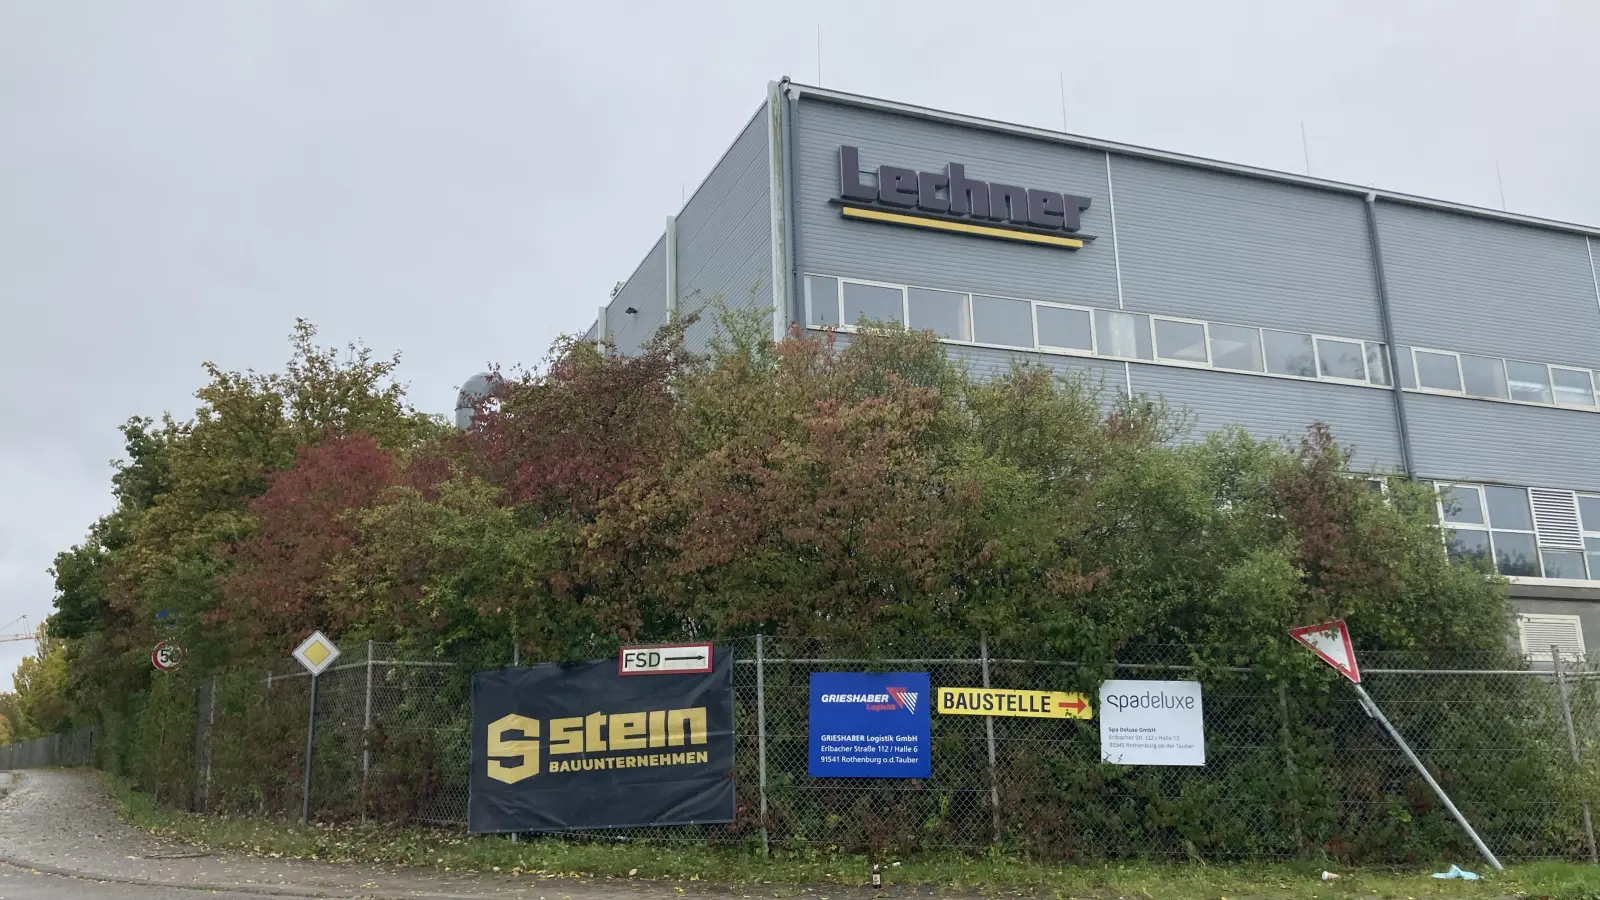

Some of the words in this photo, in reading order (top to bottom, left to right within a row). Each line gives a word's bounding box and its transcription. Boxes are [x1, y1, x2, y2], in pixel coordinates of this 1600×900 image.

[838, 145, 1092, 232] Lechner
[624, 652, 661, 668] FSD
[821, 694, 889, 703] GRIESHABER
[943, 692, 1051, 713] BAUSTELLE
[549, 706, 708, 755] stein
[866, 735, 894, 744] Logistik
[821, 745, 852, 753] Erlbacher
[854, 745, 876, 753] Straße
[549, 751, 709, 773] BAUUNTERNEHMEN
[841, 756, 881, 765] Rothenburg
